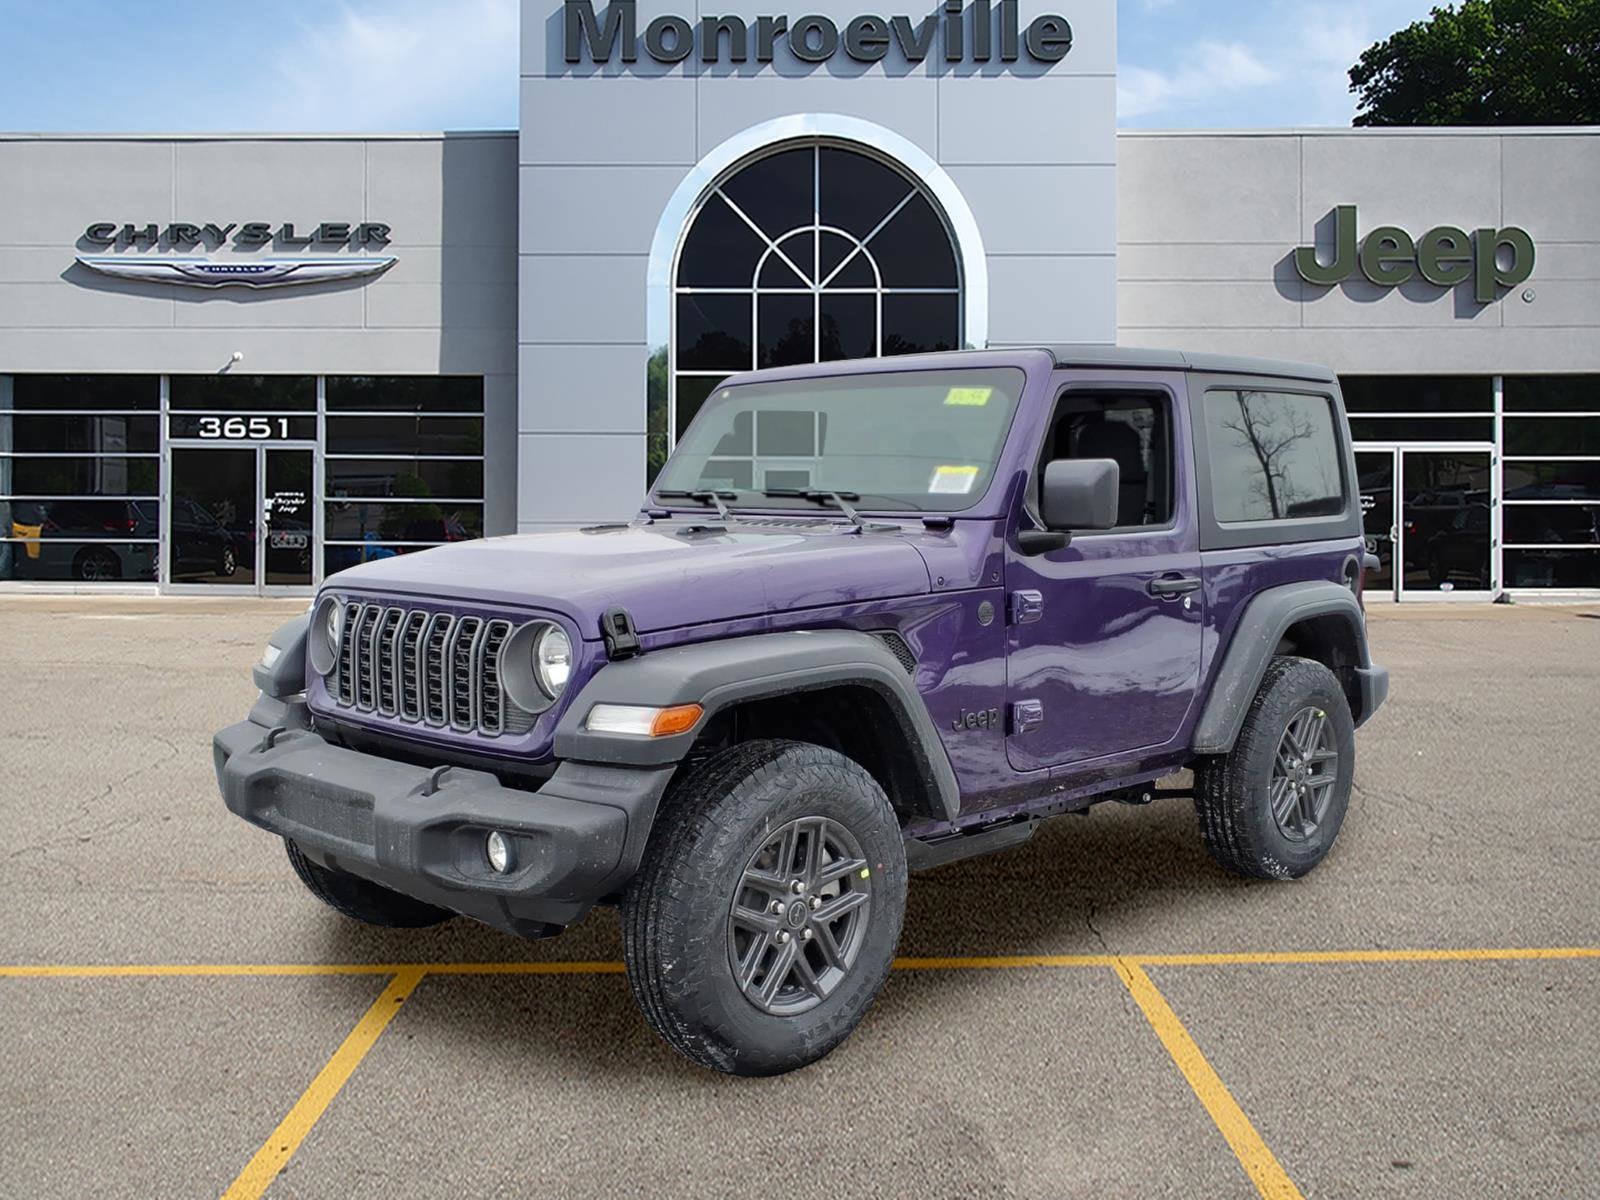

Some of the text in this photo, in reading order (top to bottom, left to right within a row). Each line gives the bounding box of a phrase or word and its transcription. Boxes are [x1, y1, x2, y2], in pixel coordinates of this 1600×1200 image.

[563, 0, 1073, 63] Monroeville
[86, 222, 391, 246] CHRYSLER
[1295, 204, 1535, 303] Jeep
[199, 417, 288, 439] 3651
[952, 708, 998, 732] Jeep
